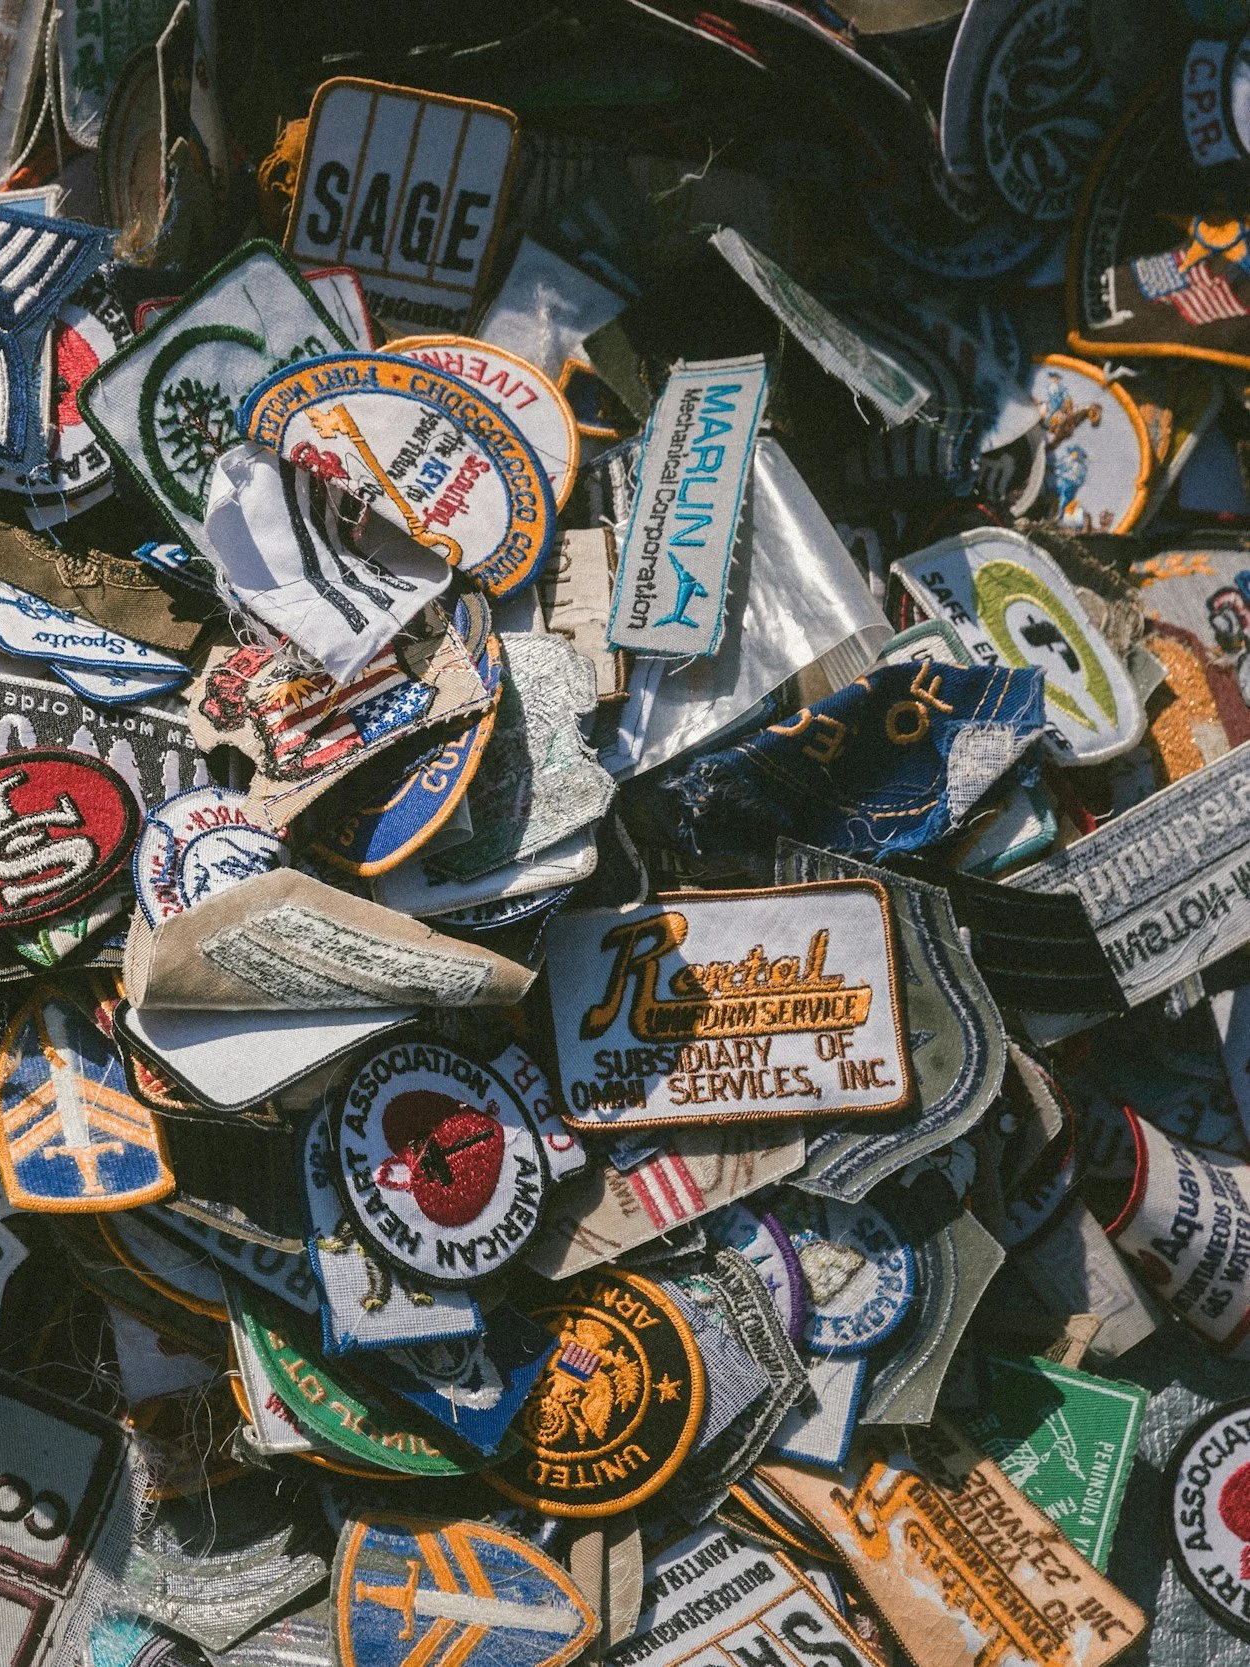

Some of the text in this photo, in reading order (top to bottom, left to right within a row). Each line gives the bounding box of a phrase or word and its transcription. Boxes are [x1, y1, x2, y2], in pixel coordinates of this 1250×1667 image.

[306, 160, 491, 273] SAGE
[311, 365, 379, 395] FORT
[414, 454, 453, 496] KEY
[422, 453, 492, 529] Scouting
[672, 383, 743, 549] MARLIN
[626, 386, 702, 631] Mechanical Corporation
[918, 570, 969, 630] SAFE
[31, 627, 127, 660] Sposito
[81, 708, 155, 739] world
[578, 911, 843, 1042] Rental
[762, 994, 857, 1027] SERVICE
[568, 1058, 897, 1112] OMNI SERVICES, INC.
[592, 1031, 855, 1083] SUBSIDIARY OF
[344, 1046, 491, 1139] ASSOCIATION
[345, 1146, 422, 1258] HEART
[434, 1154, 541, 1268] AMERICAN
[528, 1443, 653, 1492] UNITED
[1079, 1439, 1116, 1528] PENINSULA
